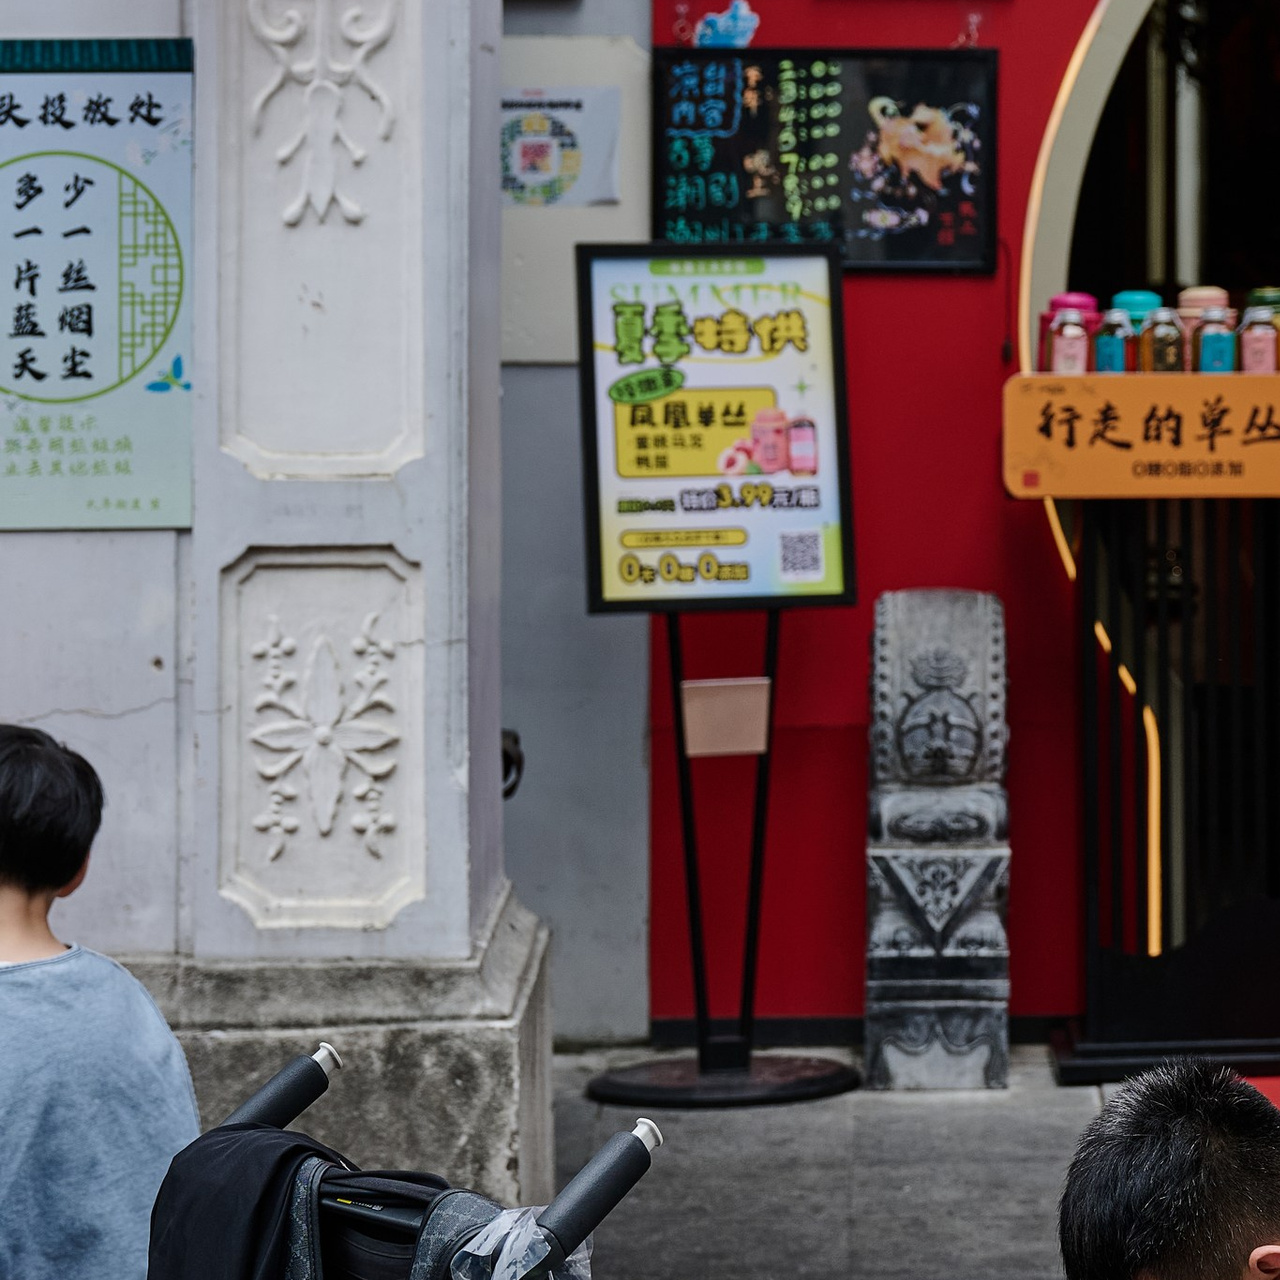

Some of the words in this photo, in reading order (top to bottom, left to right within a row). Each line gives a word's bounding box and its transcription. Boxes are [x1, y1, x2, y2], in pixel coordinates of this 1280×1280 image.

[9, 172, 47, 382] 多一片蓝天
